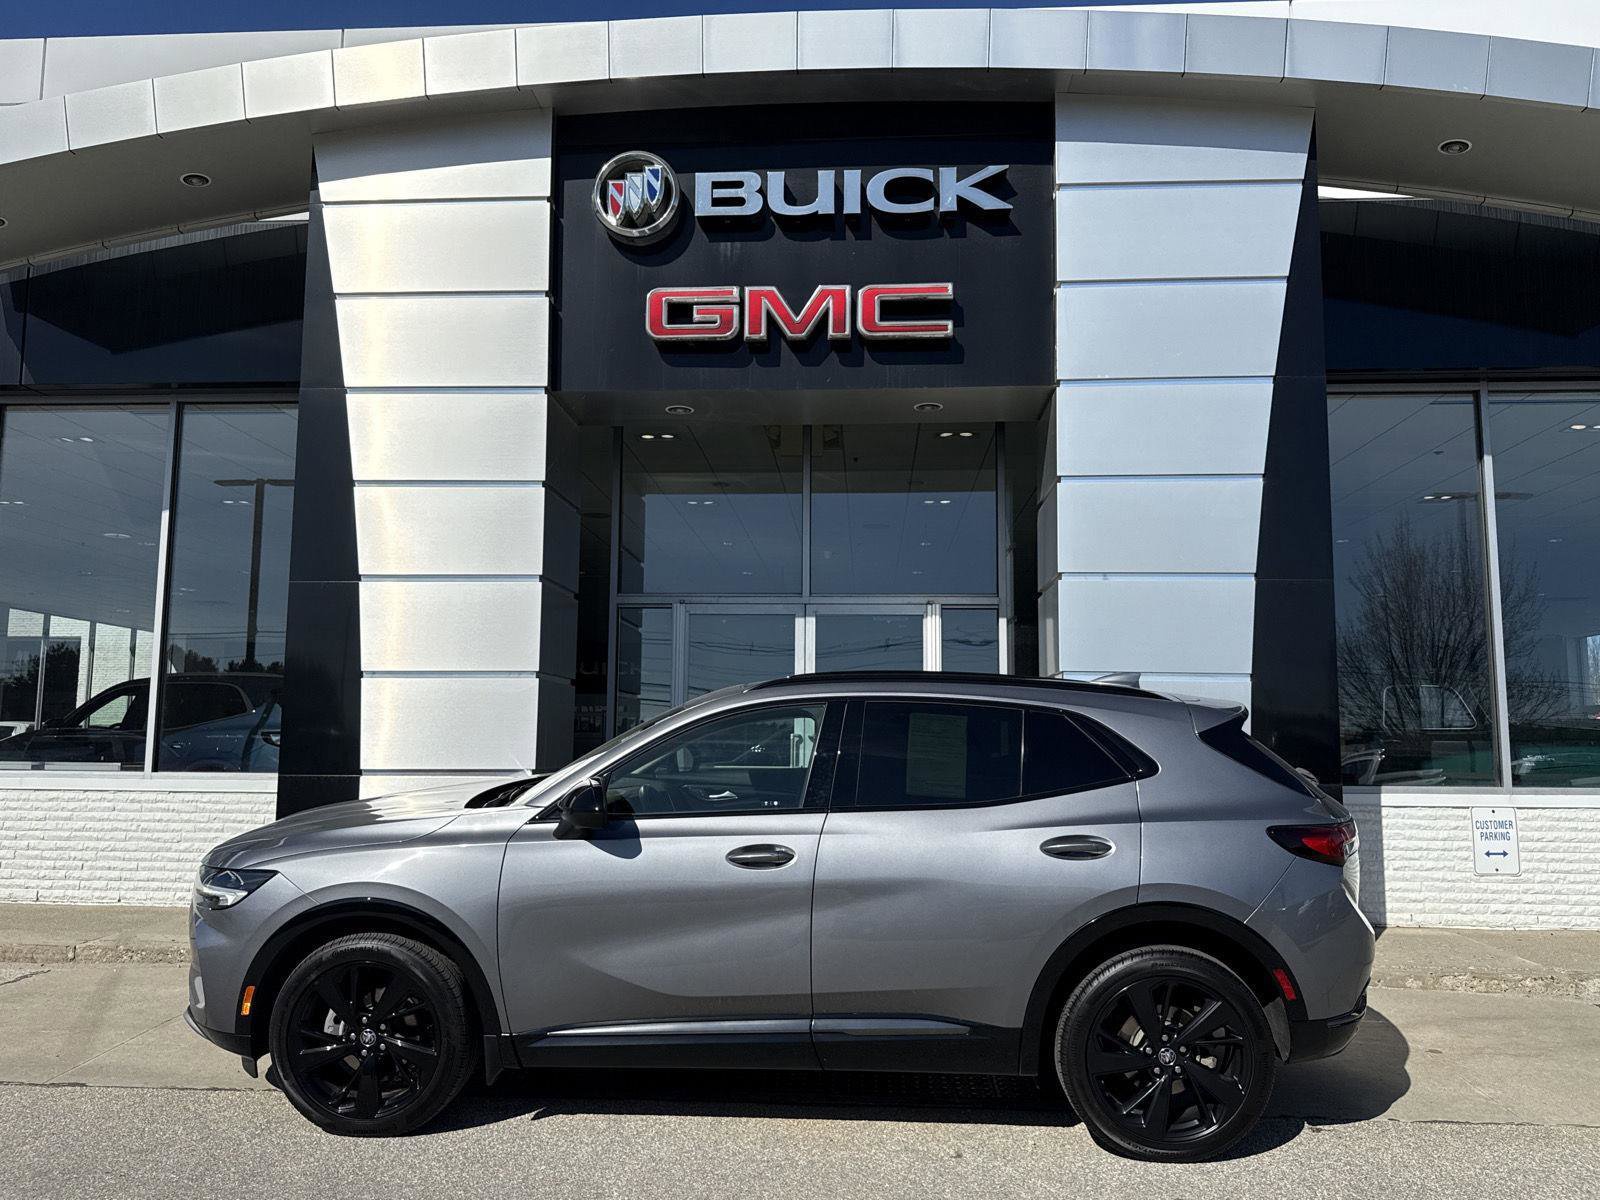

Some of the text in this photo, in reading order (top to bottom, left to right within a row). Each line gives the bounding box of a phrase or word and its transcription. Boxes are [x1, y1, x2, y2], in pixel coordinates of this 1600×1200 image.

[694, 164, 1013, 216] BUICK
[645, 282, 953, 342] GMC
[1475, 820, 1514, 830] CUSTOMER
[1480, 831, 1511, 841] PARKING
